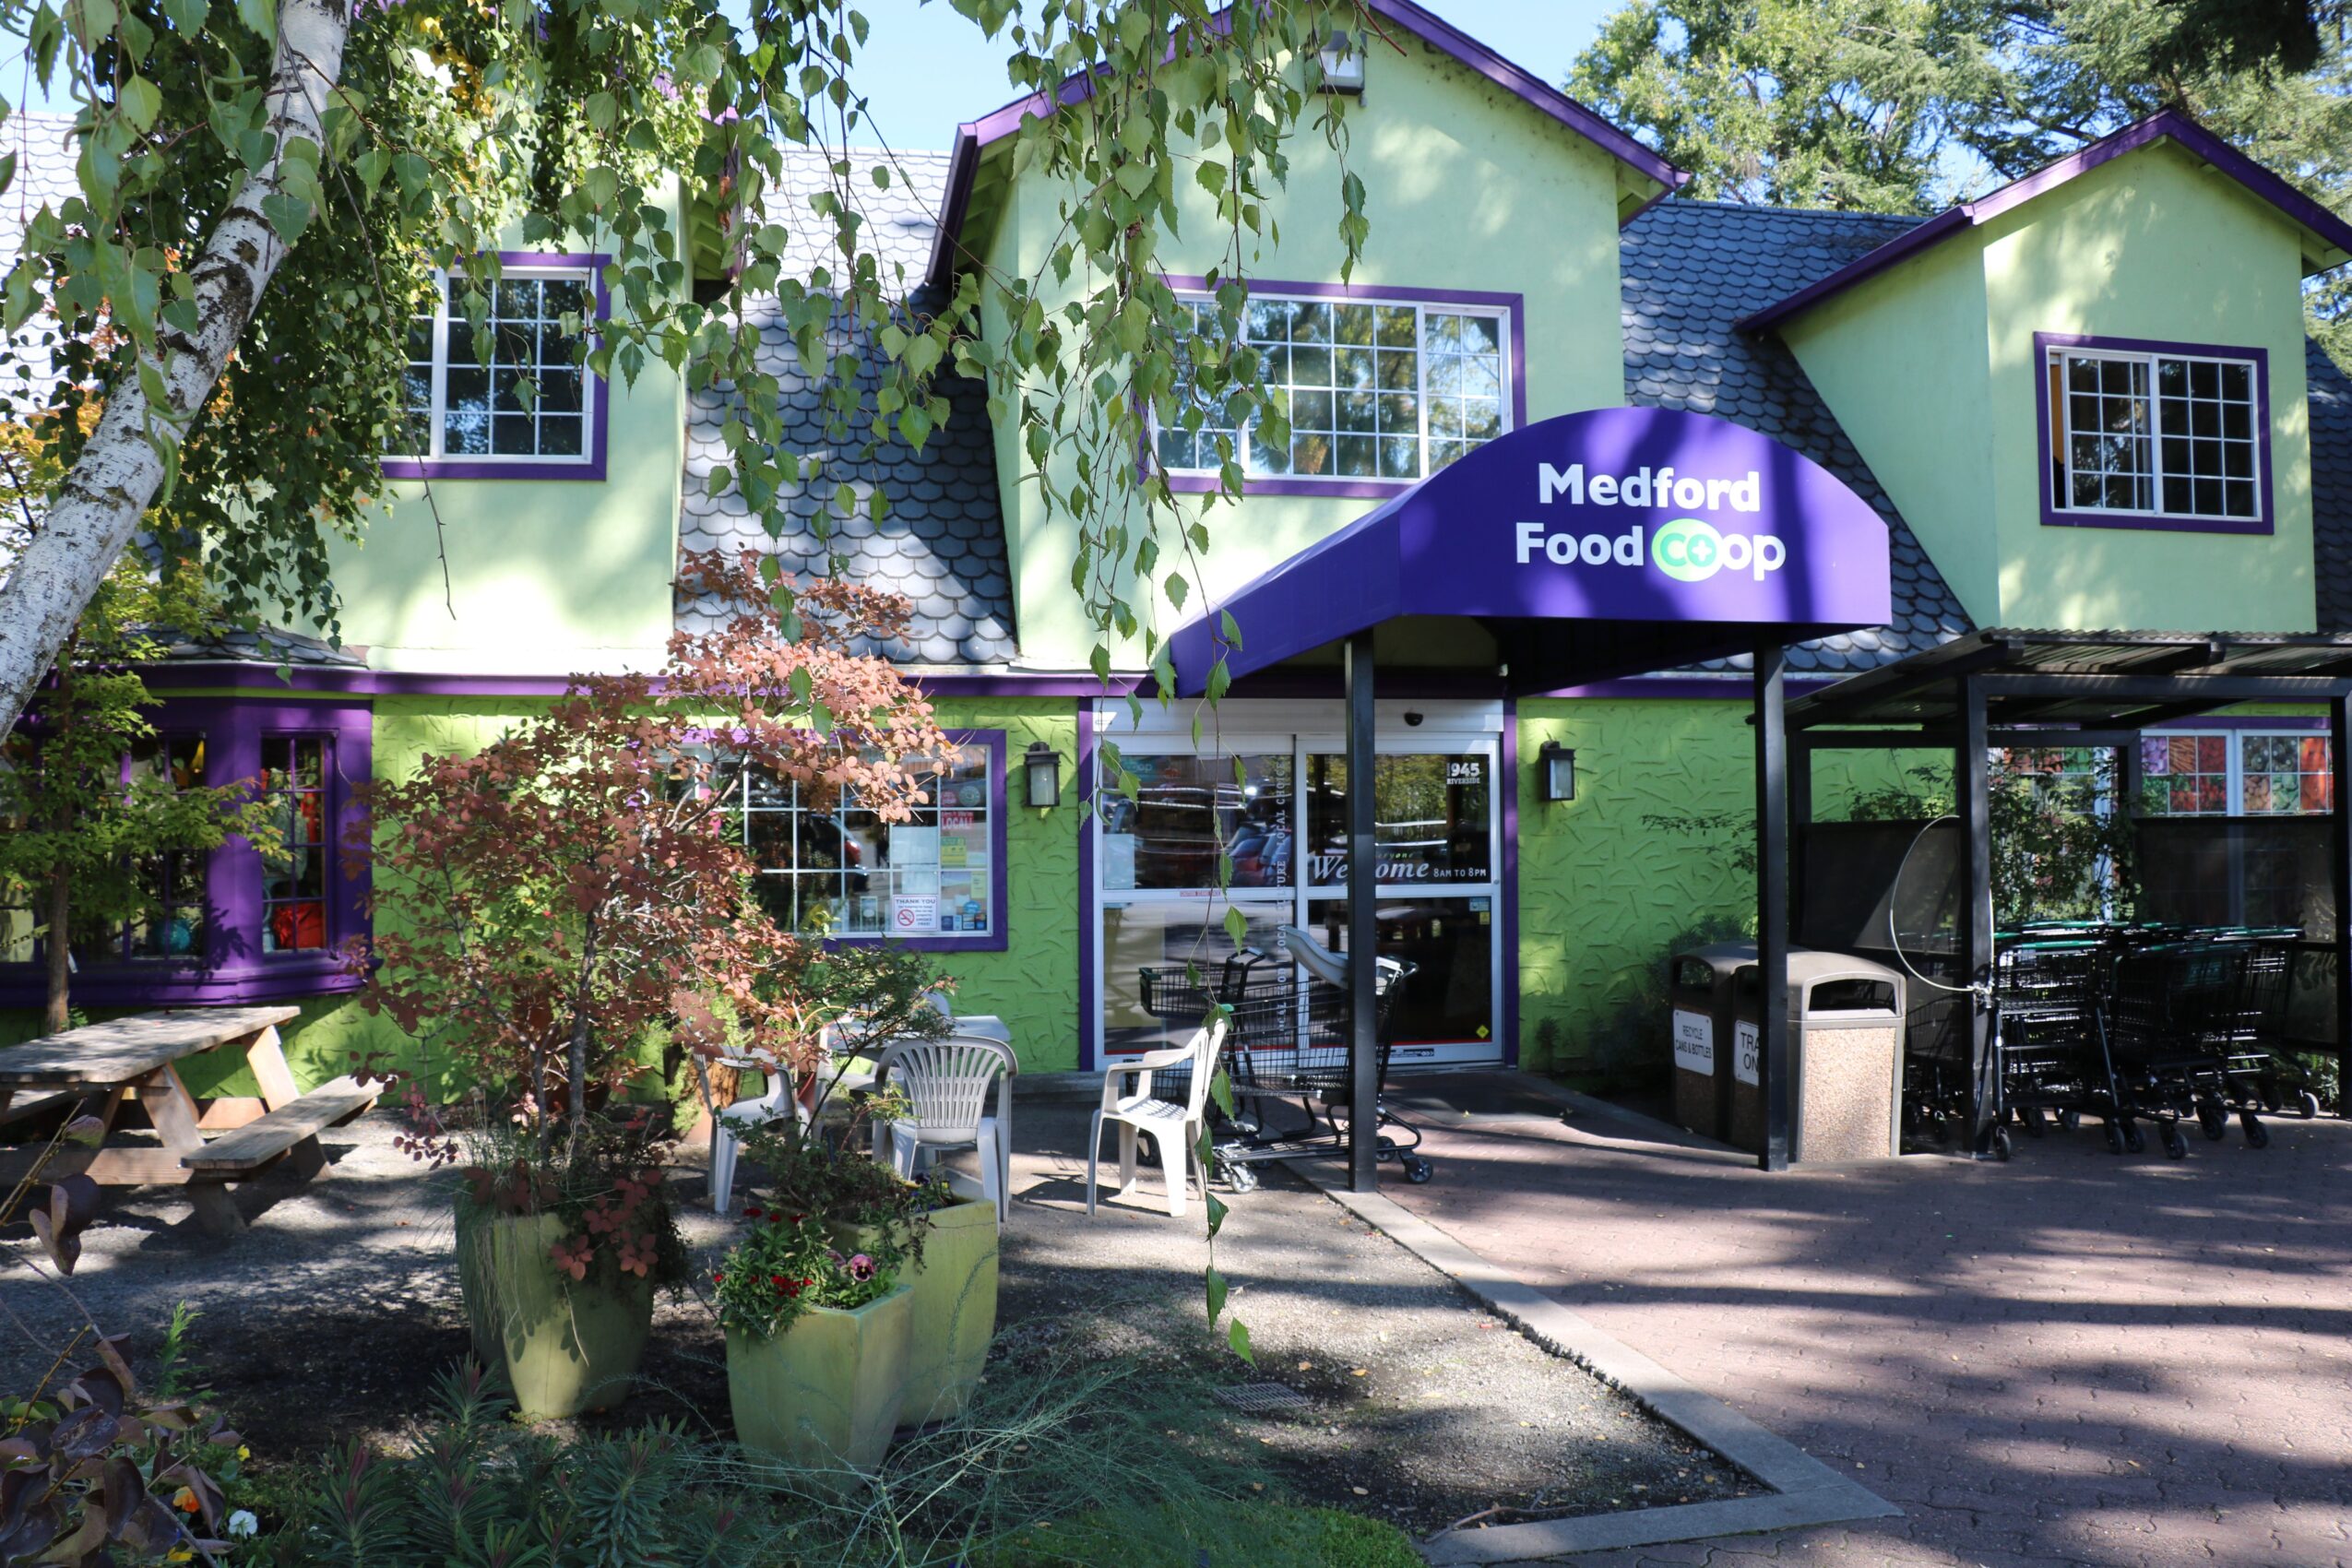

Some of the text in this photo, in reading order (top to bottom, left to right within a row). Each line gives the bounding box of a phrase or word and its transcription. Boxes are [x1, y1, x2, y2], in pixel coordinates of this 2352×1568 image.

[1538, 462, 1760, 512] Medford
[1515, 522, 1645, 566] Food
[1450, 762, 1480, 777] 945
[1276, 809, 1286, 846] LOCAL
[1313, 855, 1487, 880] Weome 8AM TO 8PM
[1682, 1025, 1704, 1040] RECYCLE
[1675, 1039, 1688, 1052] CANS
[1692, 1043, 1713, 1060] BOTTLES
